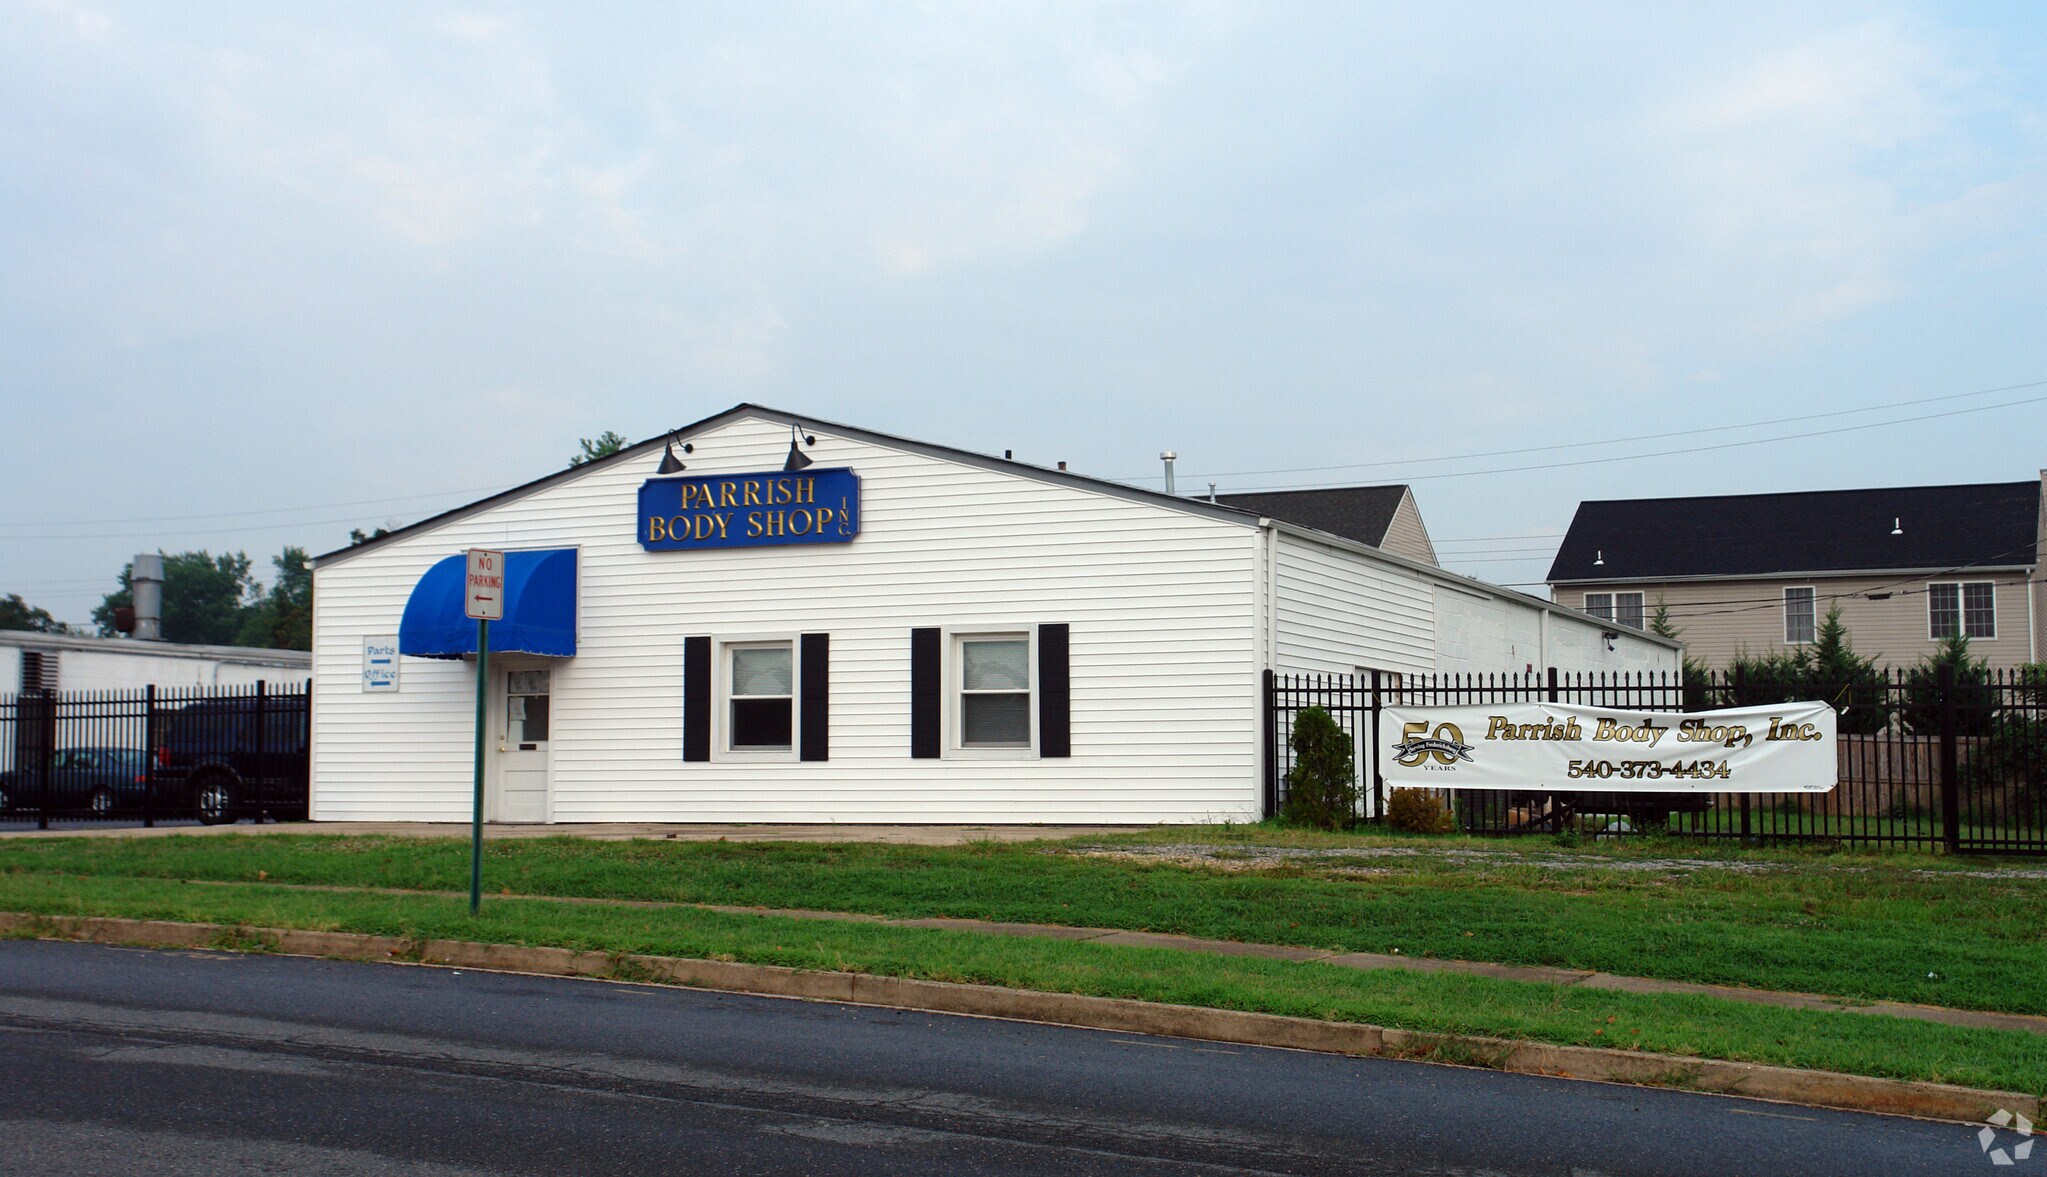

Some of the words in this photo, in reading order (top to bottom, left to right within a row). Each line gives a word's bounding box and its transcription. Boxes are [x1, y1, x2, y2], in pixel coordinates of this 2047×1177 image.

[681, 477, 815, 510] PARRISH
[649, 512, 733, 542] BODY
[747, 507, 833, 538] SHOP
[478, 557, 492, 571] NO
[469, 574, 502, 589] PARKING
[367, 645, 395, 656] Parts
[364, 669, 396, 681] Office
[1485, 715, 1582, 741] Parrish
[1593, 717, 1668, 748] Body
[1677, 718, 1753, 747] Shop,
[1766, 716, 1823, 741] Inc.
[1398, 720, 1464, 767] 50
[1567, 760, 1731, 779] 540-373-4434
